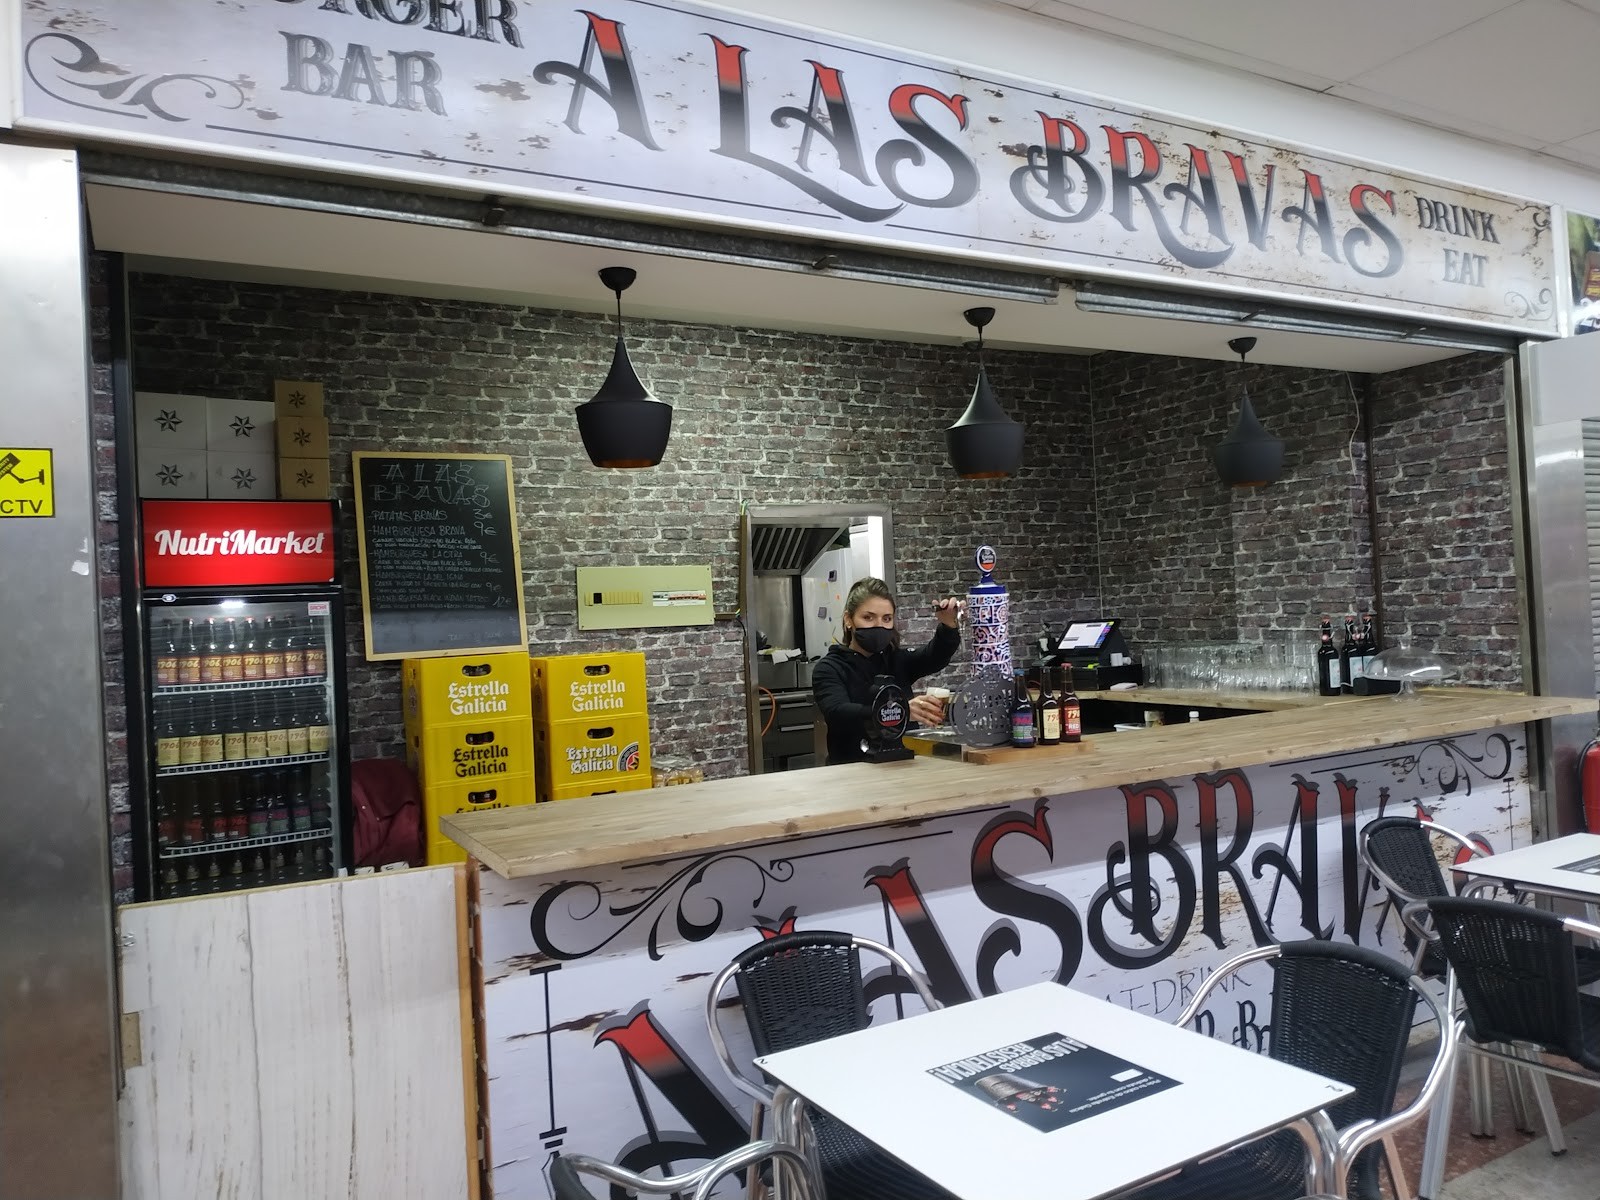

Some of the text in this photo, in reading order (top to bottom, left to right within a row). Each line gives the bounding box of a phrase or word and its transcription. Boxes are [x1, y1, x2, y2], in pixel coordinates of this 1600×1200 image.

[278, 30, 449, 117] BAR
[532, 9, 1402, 279] A LAS BRAVAS
[1414, 195, 1500, 244] DRINK
[1442, 247, 1489, 288] EAT
[368, 484, 491, 508] BRAVAS
[154, 529, 325, 556] NutriMarket
[448, 680, 510, 699] Estrella
[570, 679, 626, 697] Estrella
[450, 697, 507, 716] Galicia
[571, 695, 624, 713] Galicia
[453, 744, 509, 763] Estrella
[565, 743, 618, 761] Estrella
[455, 759, 507, 778] Galicia
[571, 758, 614, 775] Galicia
[929, 1042, 1035, 1085] RESISTENCIA!
[998, 1047, 1051, 1074] BARRAS
